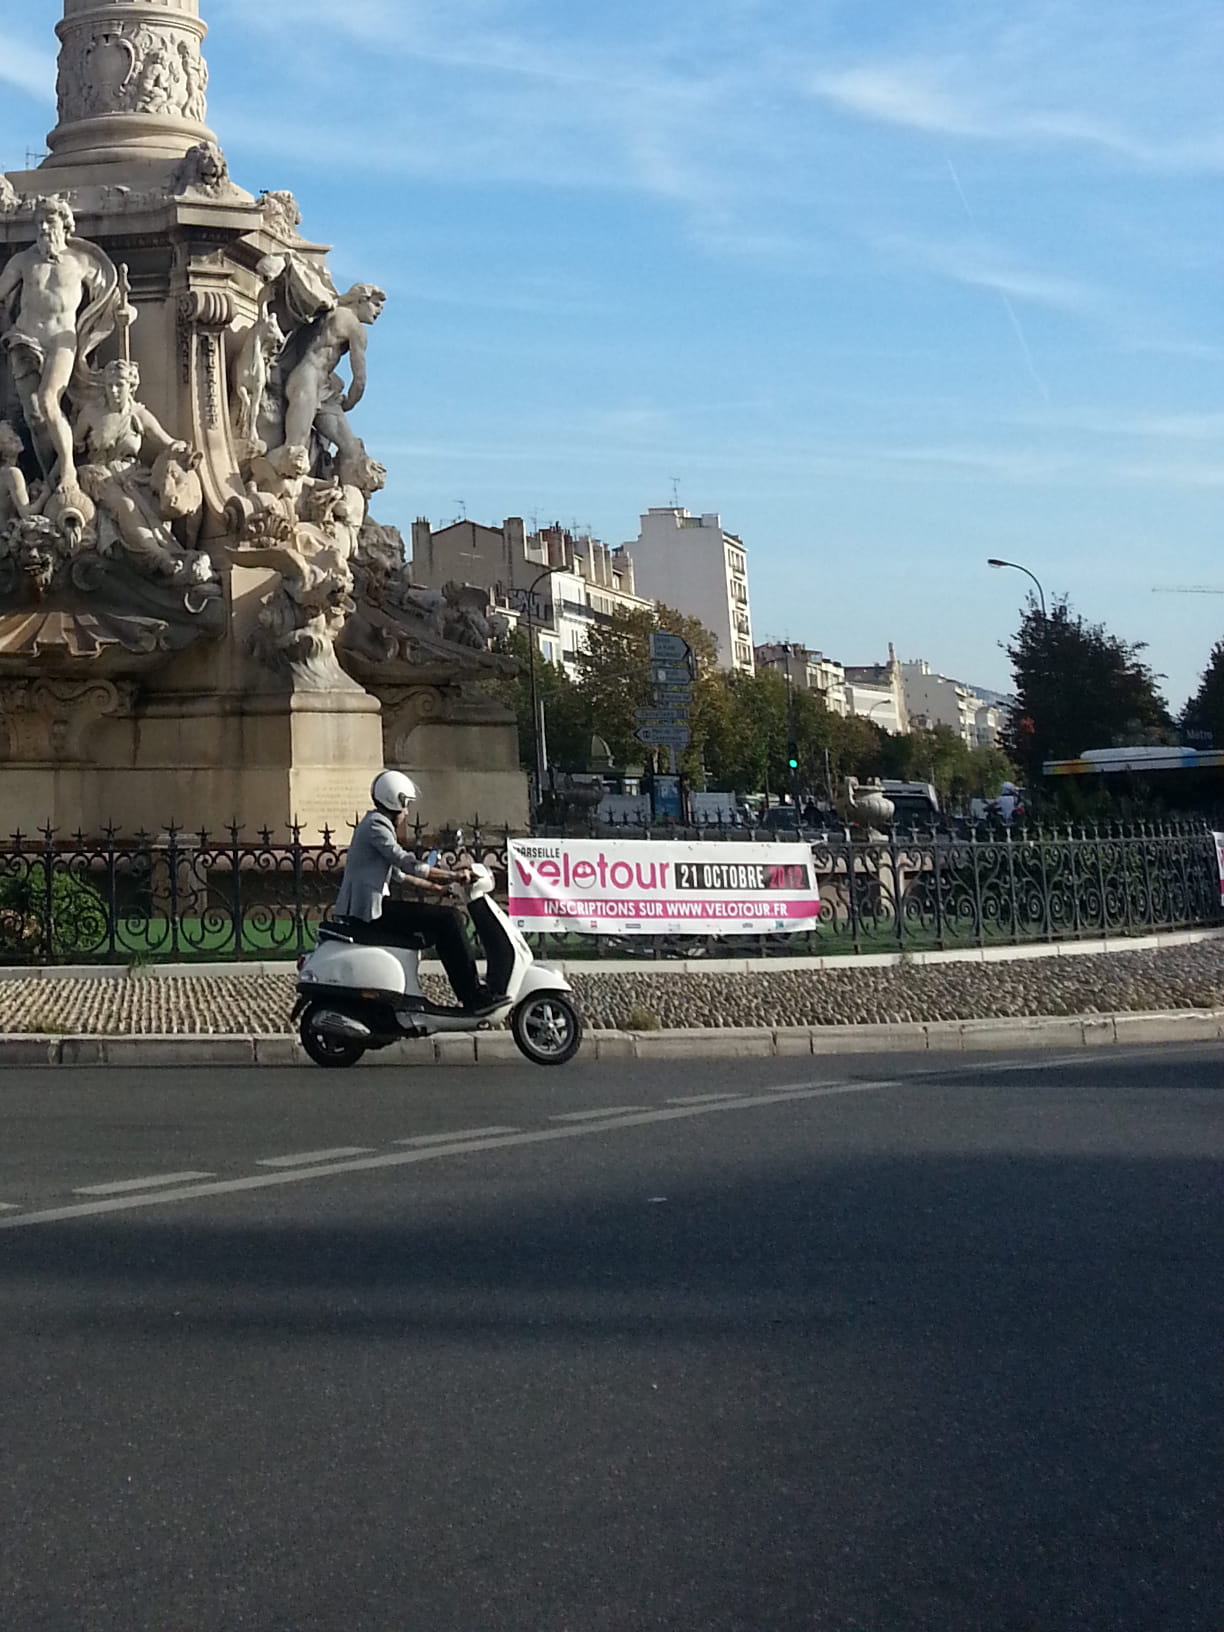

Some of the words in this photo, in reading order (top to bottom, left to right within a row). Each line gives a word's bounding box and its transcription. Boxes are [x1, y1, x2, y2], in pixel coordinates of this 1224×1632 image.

[680, 864, 698, 888] 21
[703, 865, 765, 889] OCTOBRE
[768, 865, 805, 889] 2012
[544, 900, 635, 916] INSCRIPTIONS
[639, 902, 663, 917] SUR
[666, 903, 788, 917] WWW.VELOTOUR.FR
